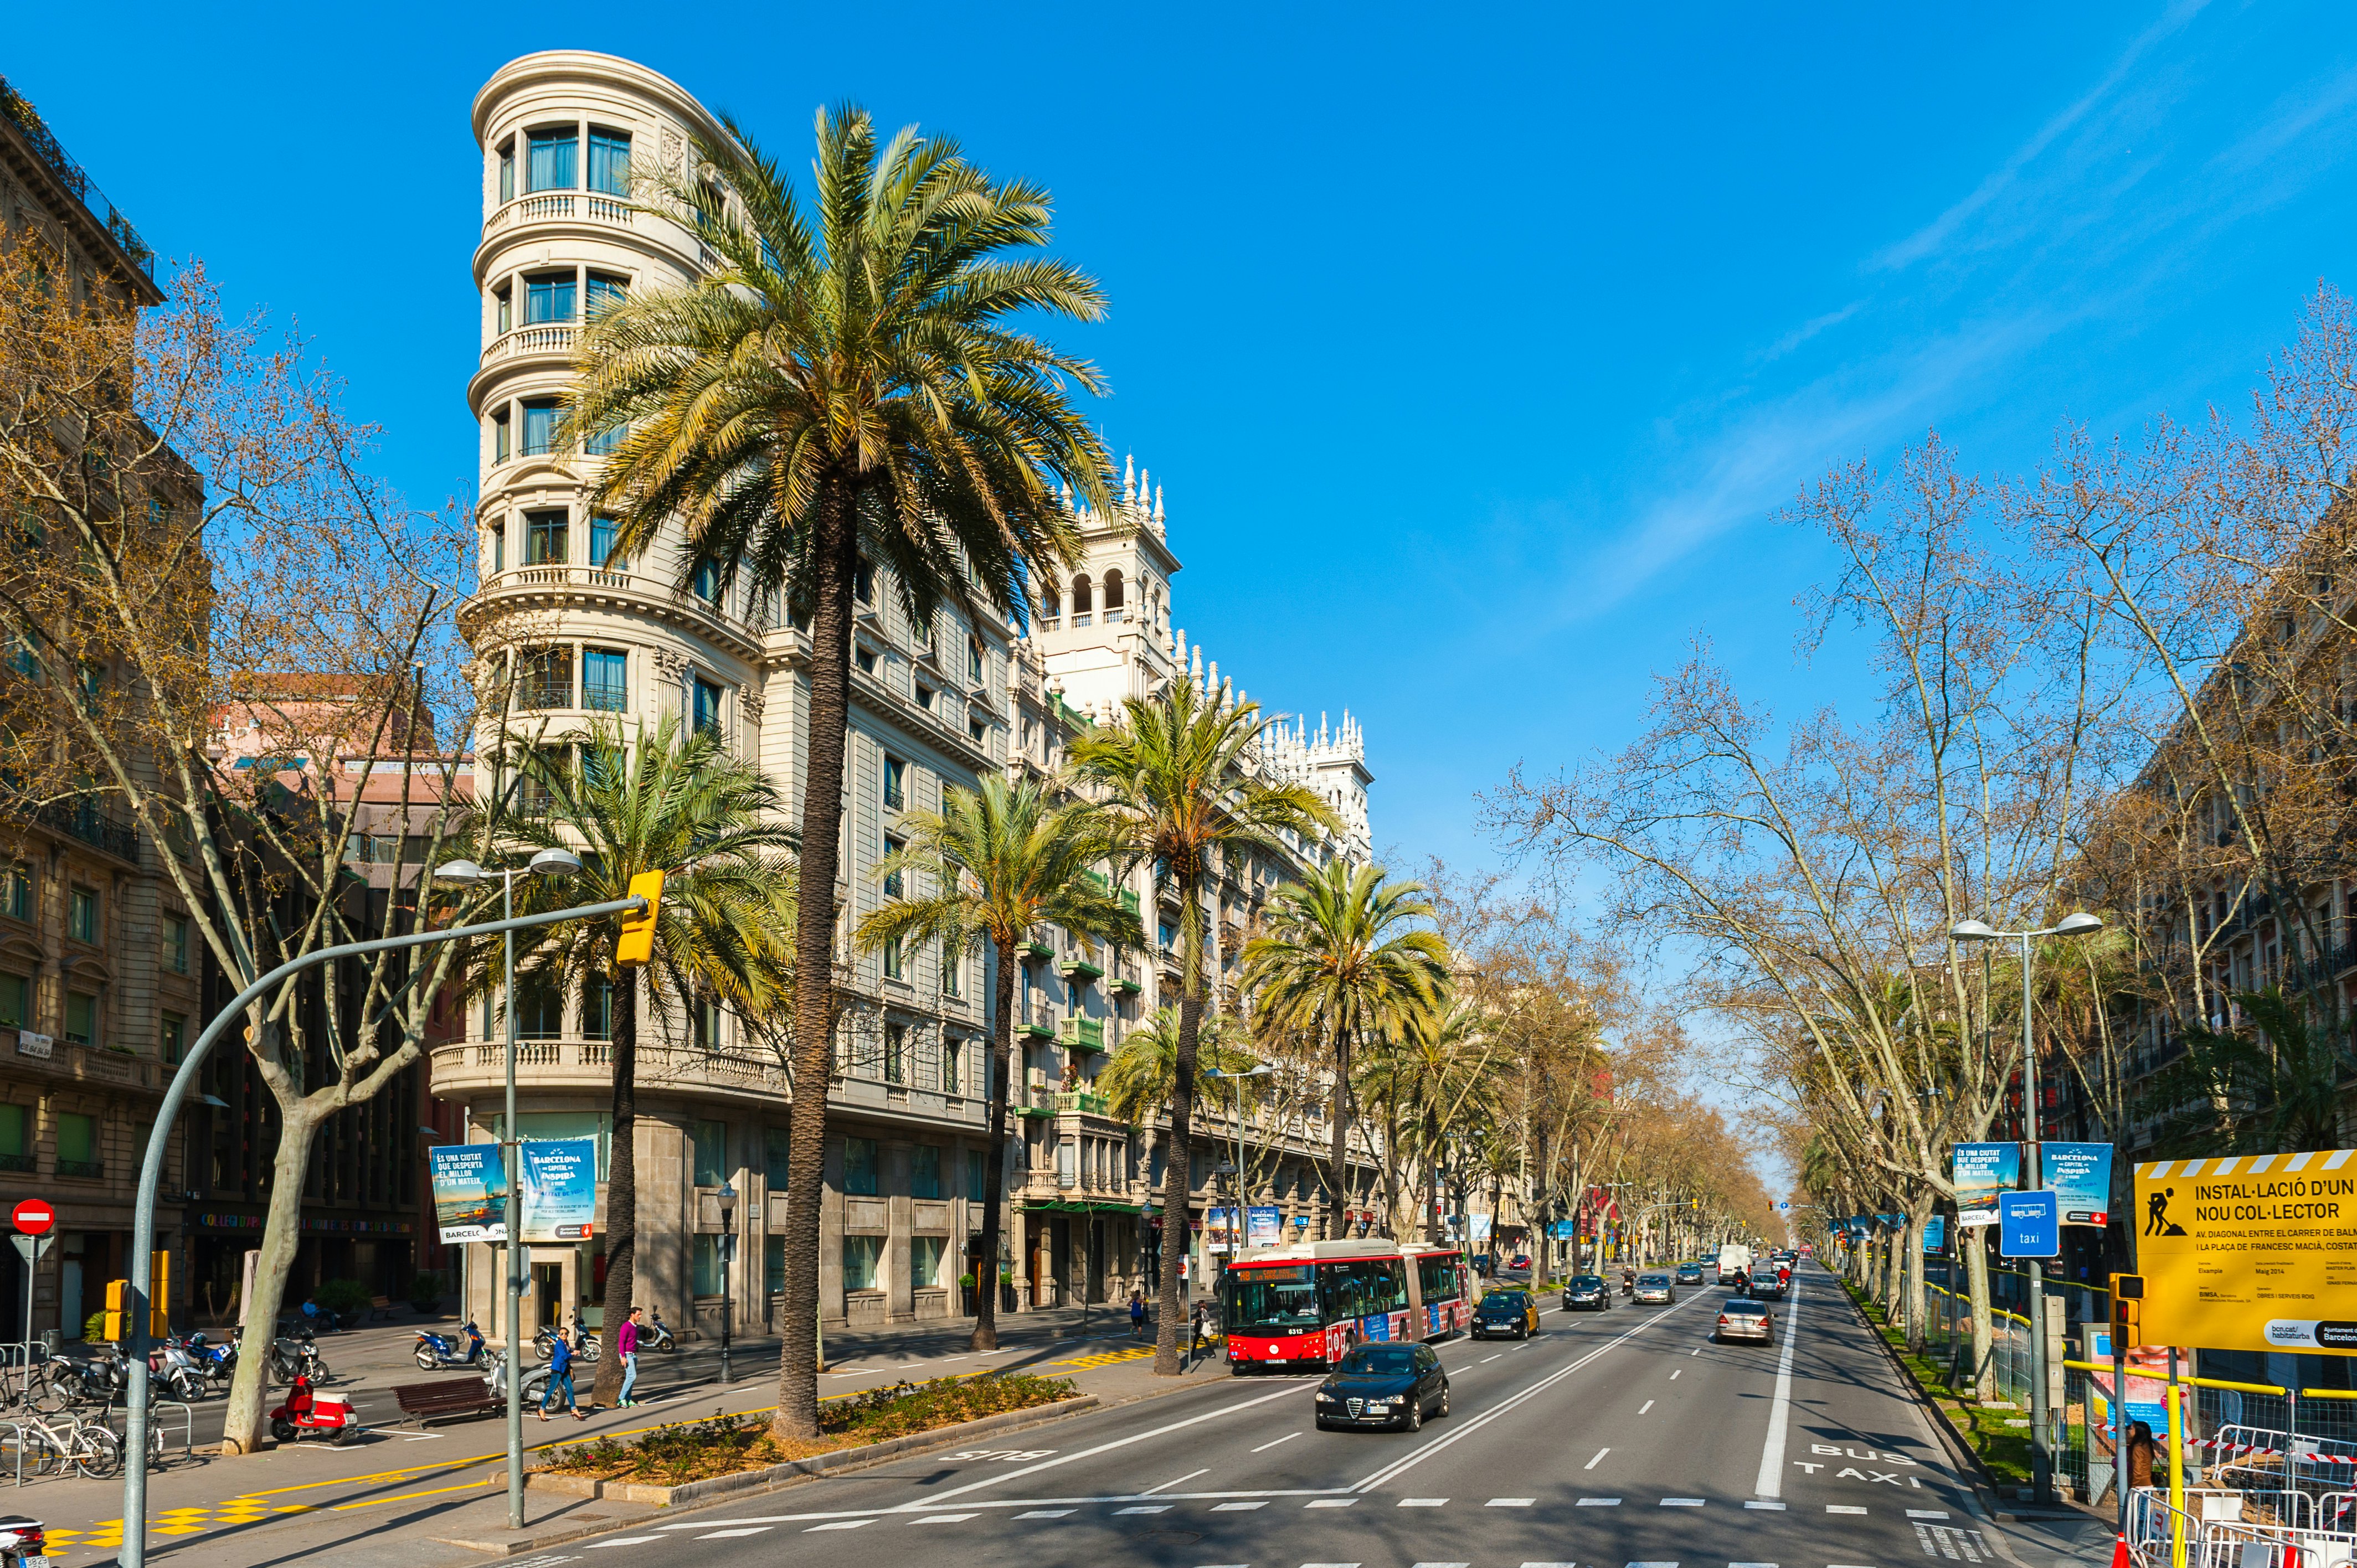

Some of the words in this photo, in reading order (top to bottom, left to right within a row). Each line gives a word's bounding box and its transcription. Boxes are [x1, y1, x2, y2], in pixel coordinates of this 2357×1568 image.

[437, 1153, 445, 1163] ÉS
[460, 1153, 482, 1161] CIUTAT
[533, 1156, 581, 1164] BARCELONA
[438, 1162, 451, 1171] QUE
[452, 1161, 483, 1169] DESPERTA
[449, 1169, 472, 1178] MILLOR
[541, 1172, 576, 1180] INSPIRA
[440, 1179, 456, 1187] D'UN
[457, 1177, 483, 1185] MATEIX.
[2311, 1179, 2354, 1196] D’UN
[2196, 1206, 2230, 1221] NOU
[2235, 1203, 2339, 1220] COL·LECTOR
[2020, 1232, 2039, 1244] taxi
[2211, 1244, 2235, 1252] PLAÇA
[2295, 1240, 2325, 1251] MACIÀ,
[1240, 1271, 1250, 1281] H8
[938, 1450, 1058, 1461] BUS
[1811, 1443, 1917, 1466] BUS
[1793, 1461, 1921, 1488] TAXI
[25, 1556, 47, 1566] 3829
